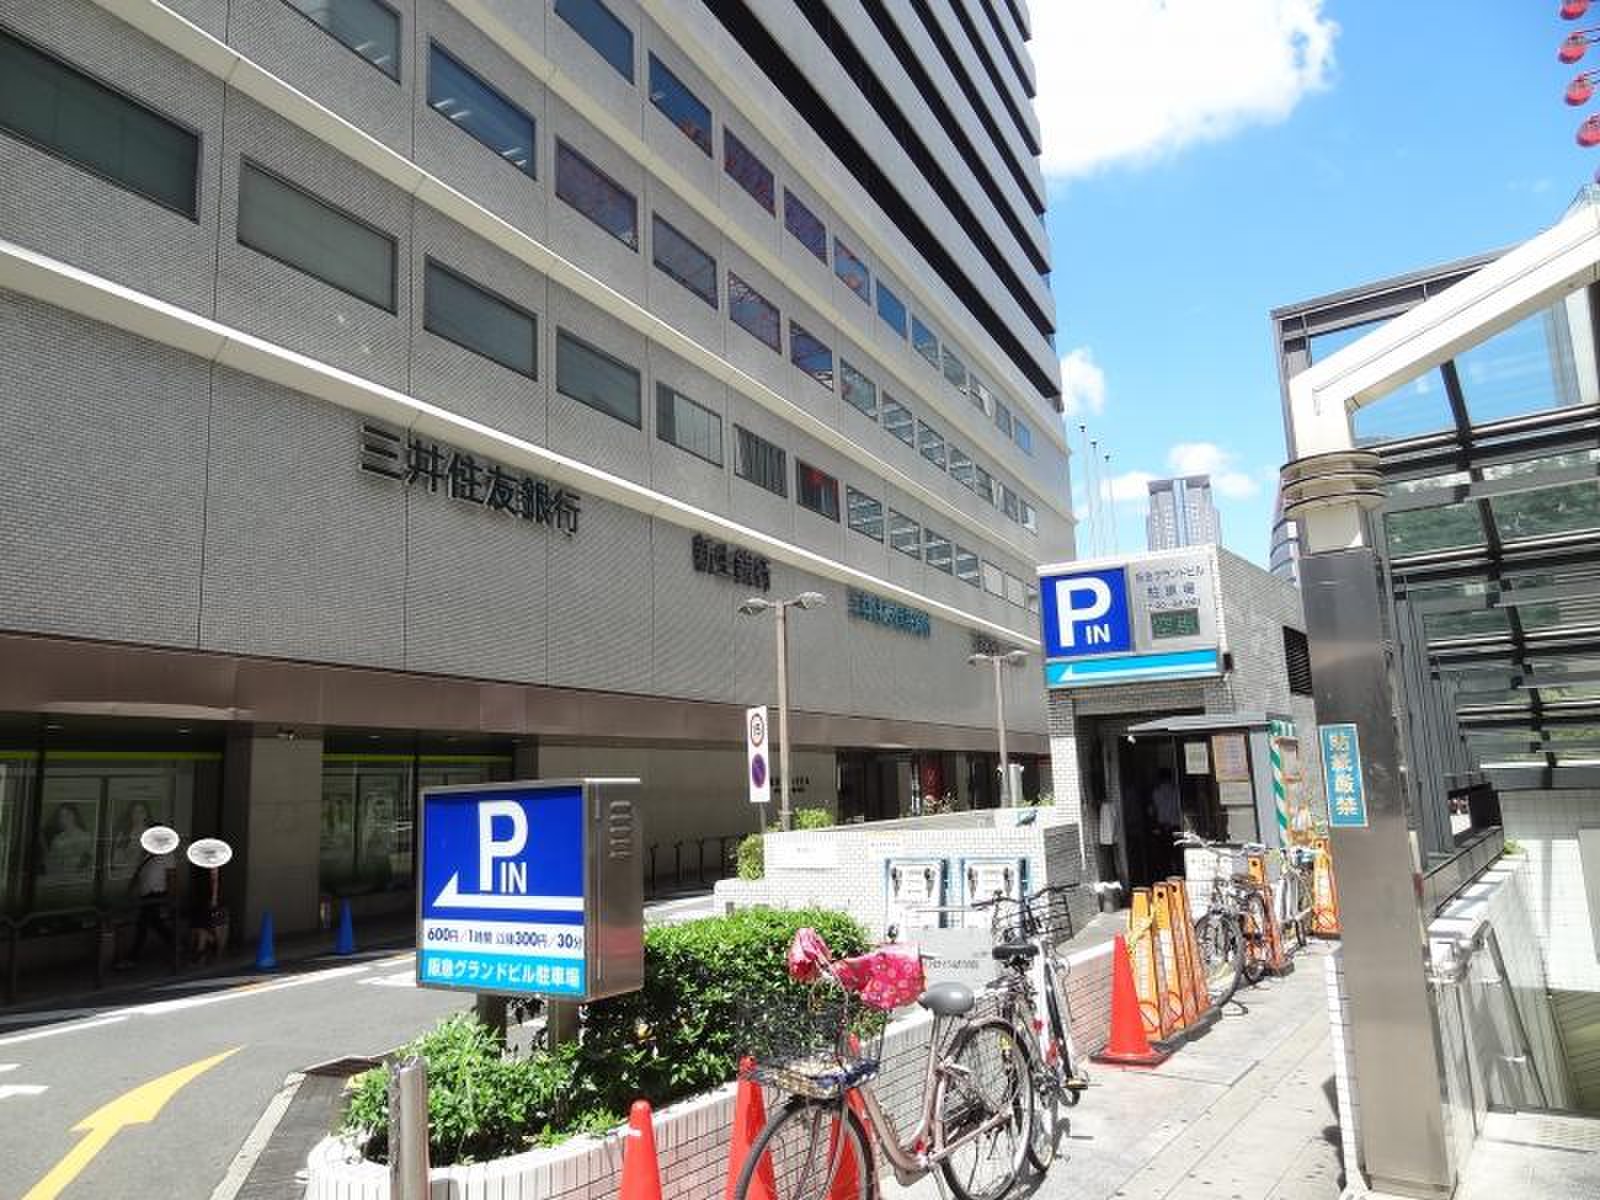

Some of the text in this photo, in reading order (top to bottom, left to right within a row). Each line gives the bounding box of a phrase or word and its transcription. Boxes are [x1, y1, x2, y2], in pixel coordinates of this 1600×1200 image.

[360, 424, 581, 538] 三井住友銀行
[1055, 577, 1112, 647] P IN
[478, 800, 529, 894] P IN
[427, 957, 580, 988] 阪急グランドビル駐車場
